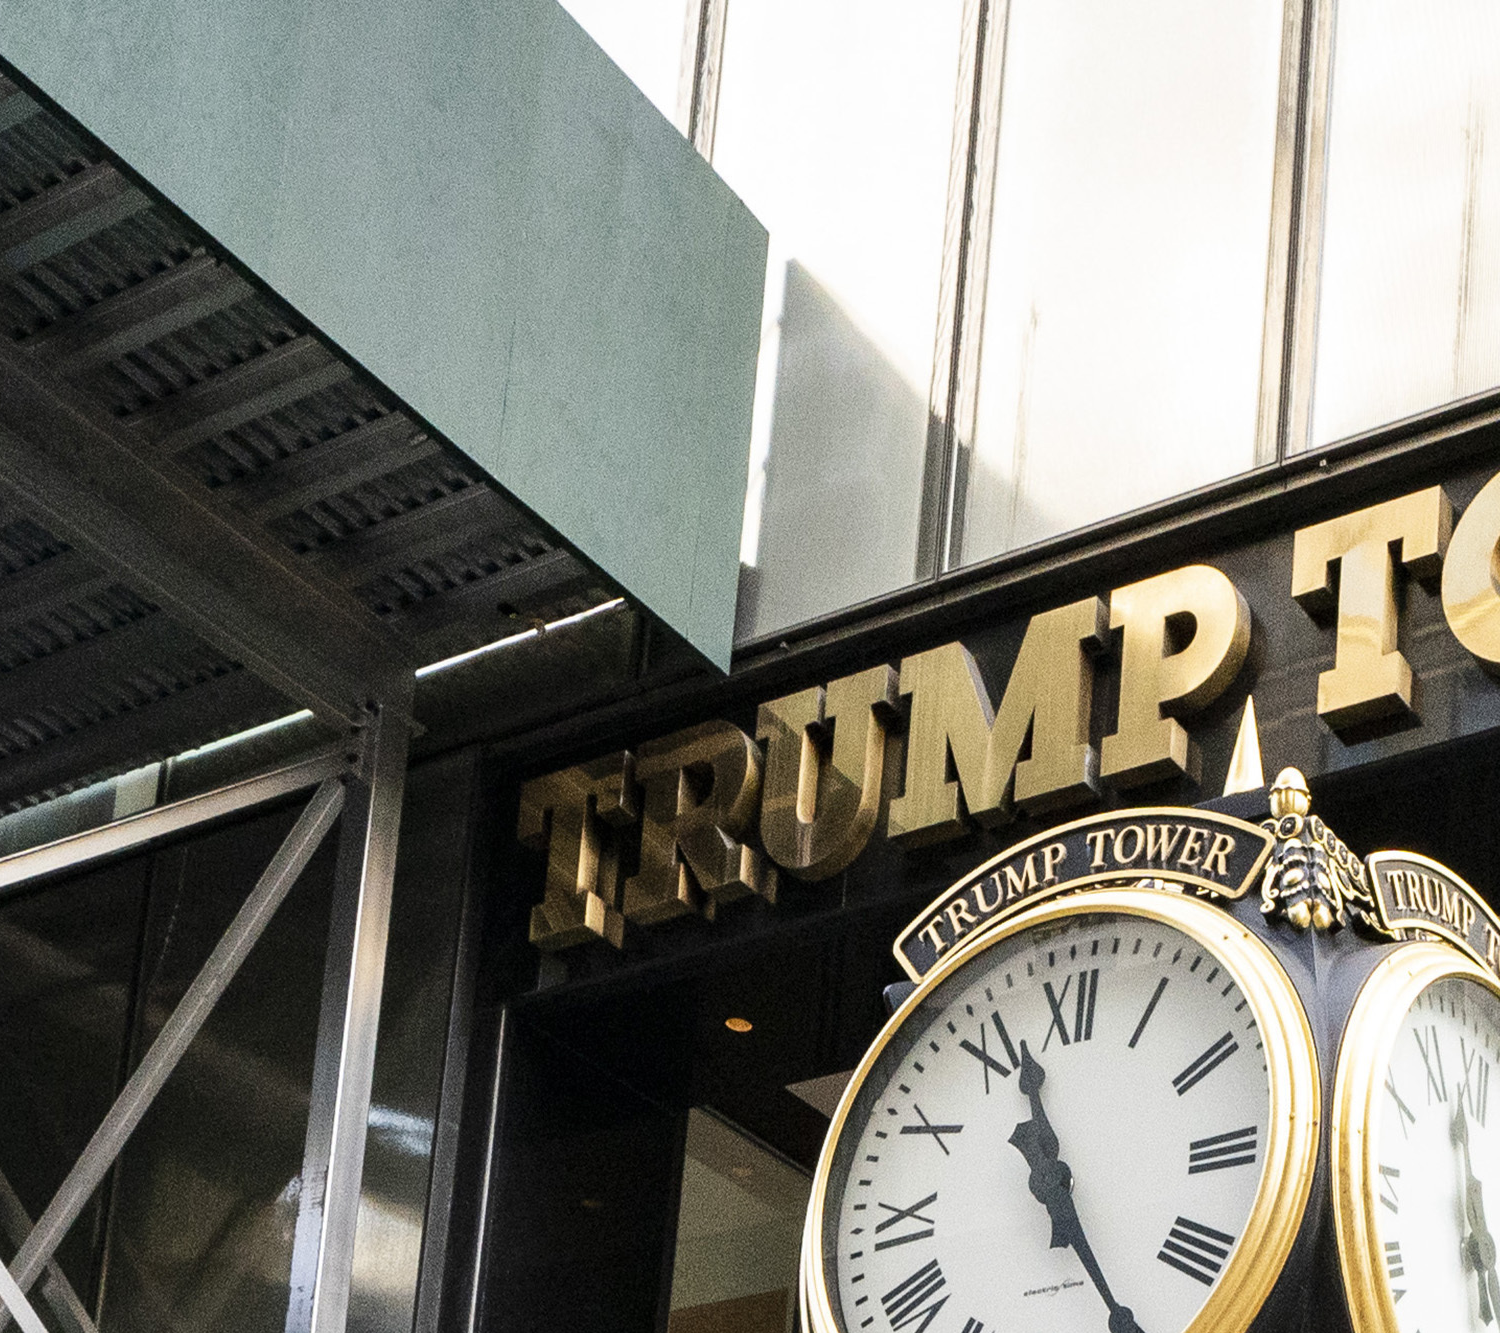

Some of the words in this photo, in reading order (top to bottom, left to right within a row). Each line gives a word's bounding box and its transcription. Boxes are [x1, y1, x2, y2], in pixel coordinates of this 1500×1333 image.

[517, 564, 1252, 951] TRUMP
[917, 842, 1067, 955] TRUMP
[1086, 823, 1236, 877] TOWER
[1385, 869, 1477, 937] TRUMP
